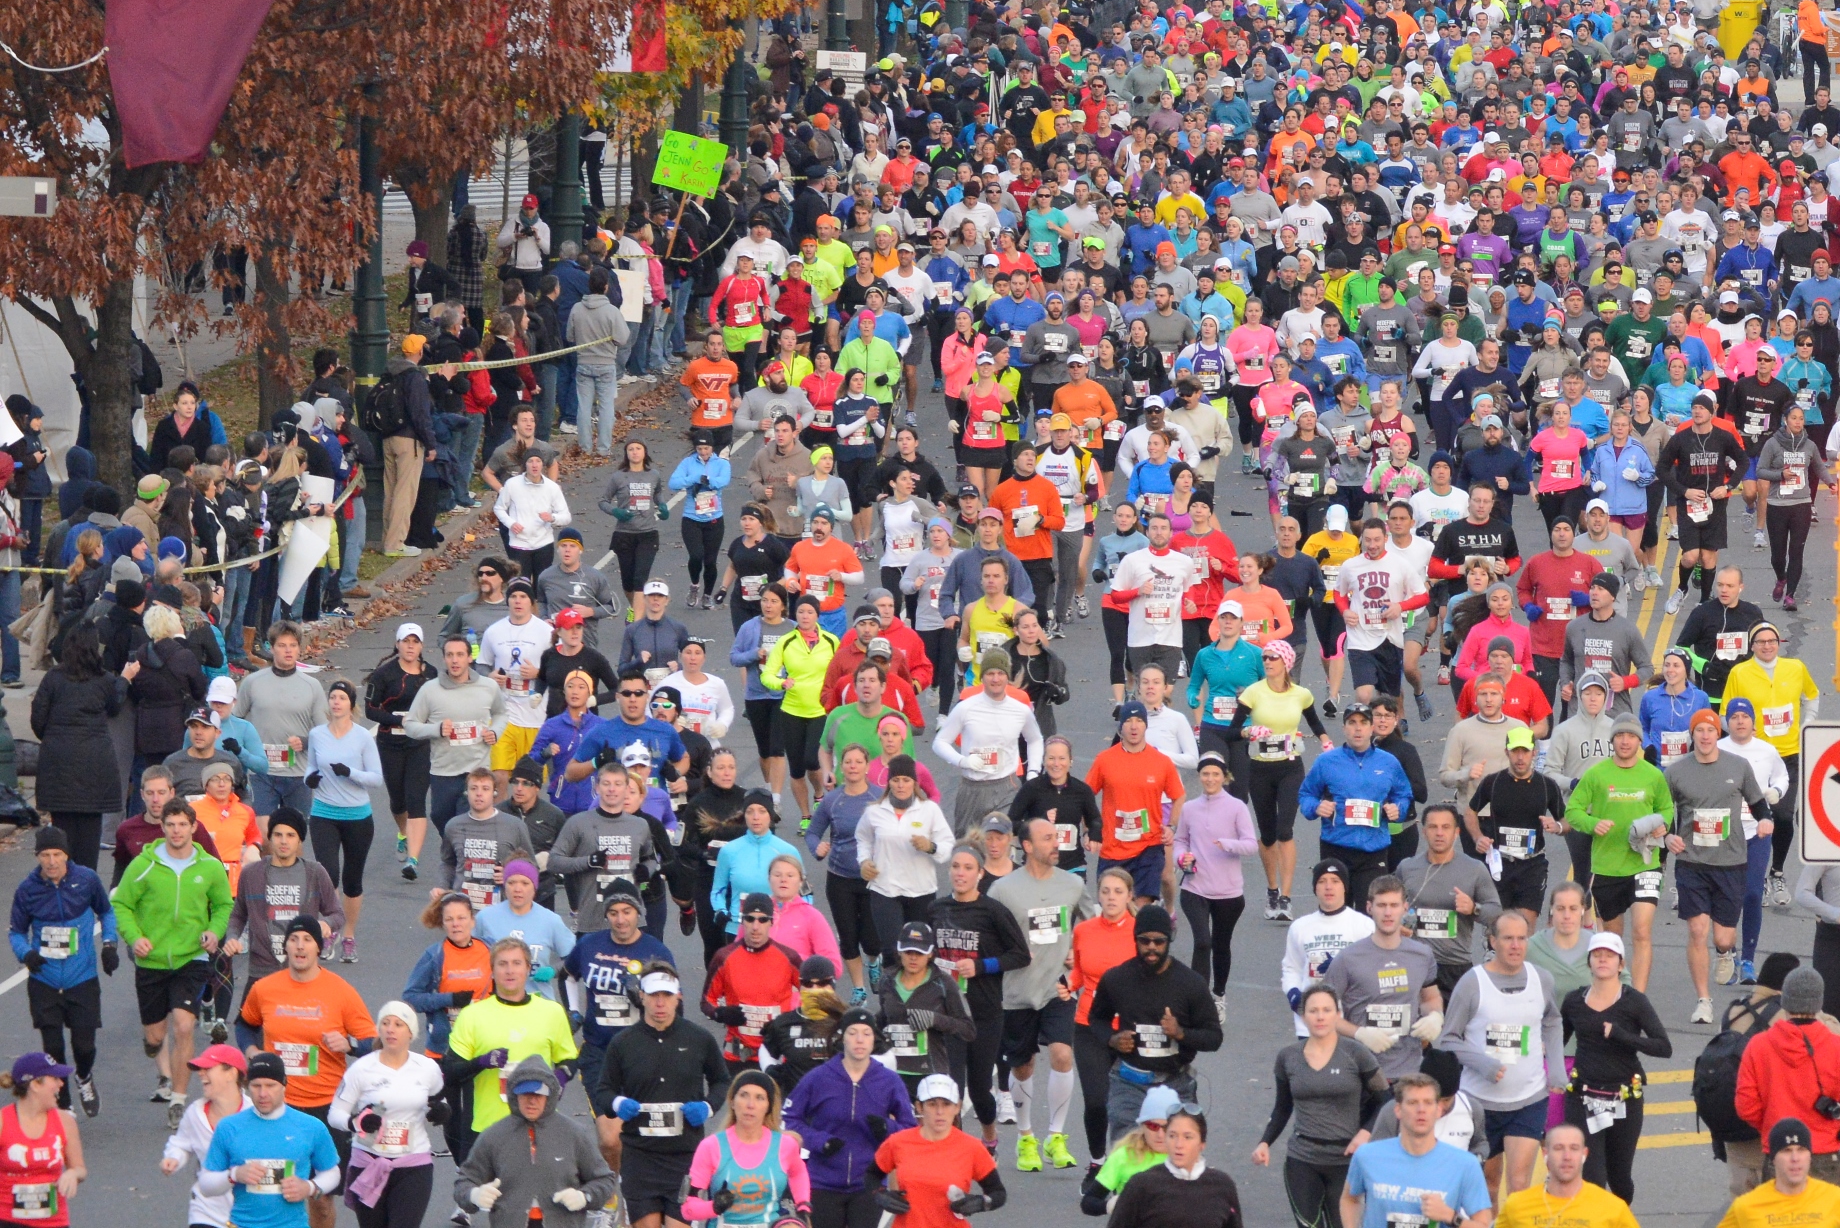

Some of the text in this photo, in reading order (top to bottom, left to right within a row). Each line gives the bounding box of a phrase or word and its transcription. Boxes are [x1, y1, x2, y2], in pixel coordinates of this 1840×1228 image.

[700, 378, 730, 392] VT
[1357, 571, 1389, 590] FDU
[1585, 638, 1613, 649] REDEFINE
[1584, 647, 1612, 657] POSSIBLE
[1580, 740, 1615, 759] GAP
[464, 838, 498, 850] REDEFINE
[599, 835, 631, 845] REDEFINE
[464, 848, 497, 860] POSSIBLE
[266, 885, 300, 895] REDEFINE
[266, 895, 300, 906] POSSIBLE
[1314, 934, 1343, 942] WEST
[1380, 976, 1399, 987] HALF
[1368, 1012, 1402, 1021] NICHOLAS
[1486, 1031, 1521, 1041] JONATHAN
[650, 1112, 663, 1120] TIM
[32, 1147, 50, 1160] BE
[1373, 1183, 1401, 1193] NEW
[1373, 1192, 1398, 1201] STATE
